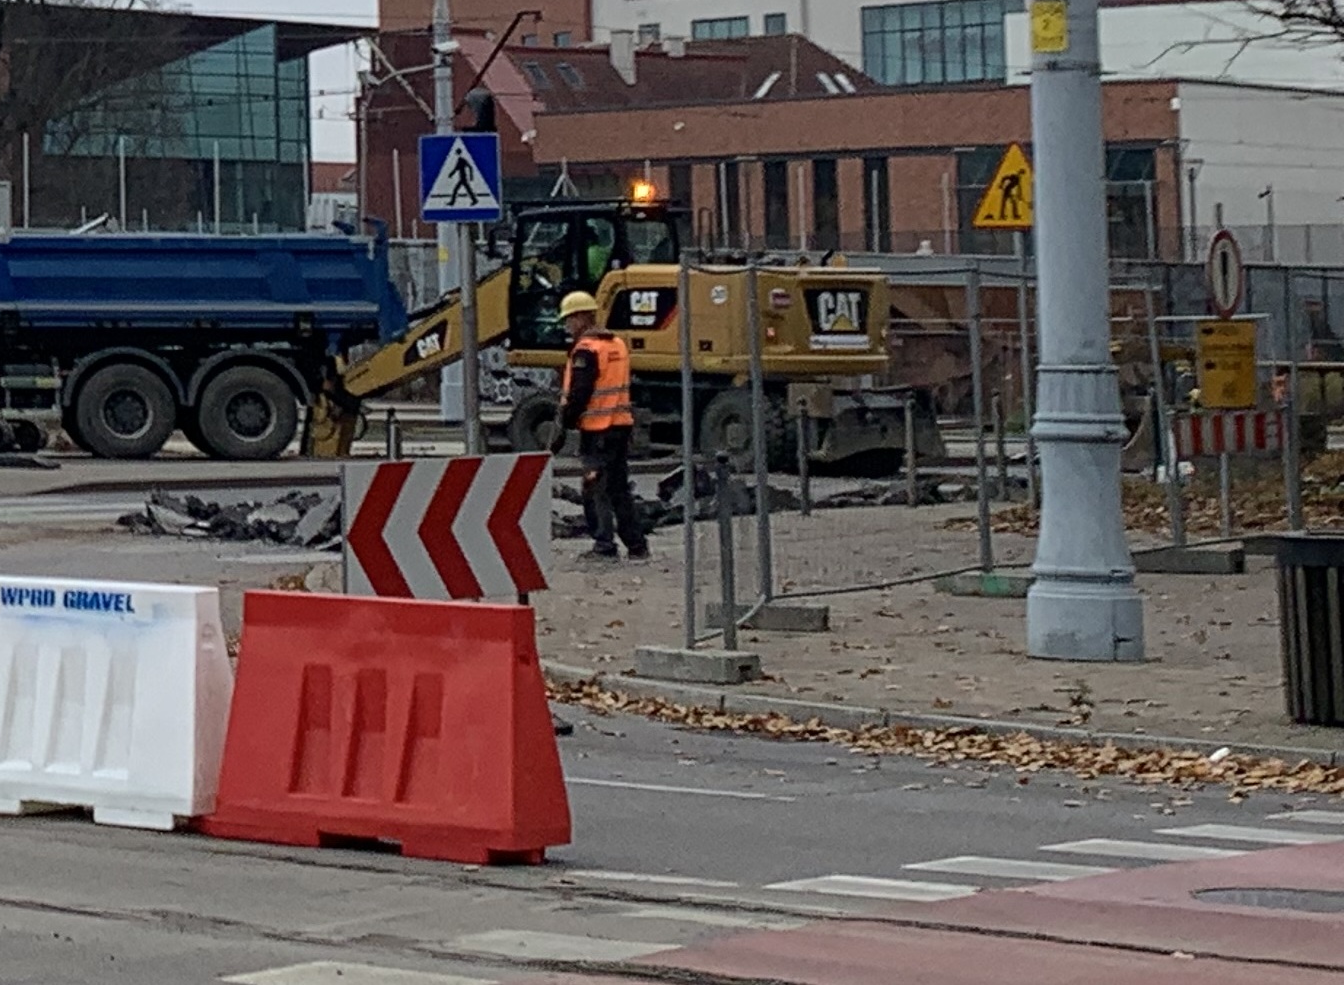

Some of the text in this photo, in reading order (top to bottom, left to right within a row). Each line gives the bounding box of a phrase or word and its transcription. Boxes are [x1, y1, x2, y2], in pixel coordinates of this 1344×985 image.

[630, 290, 659, 313] CAT
[817, 291, 861, 331] CAT
[0, 587, 135, 614] WPRD GRAVEL
